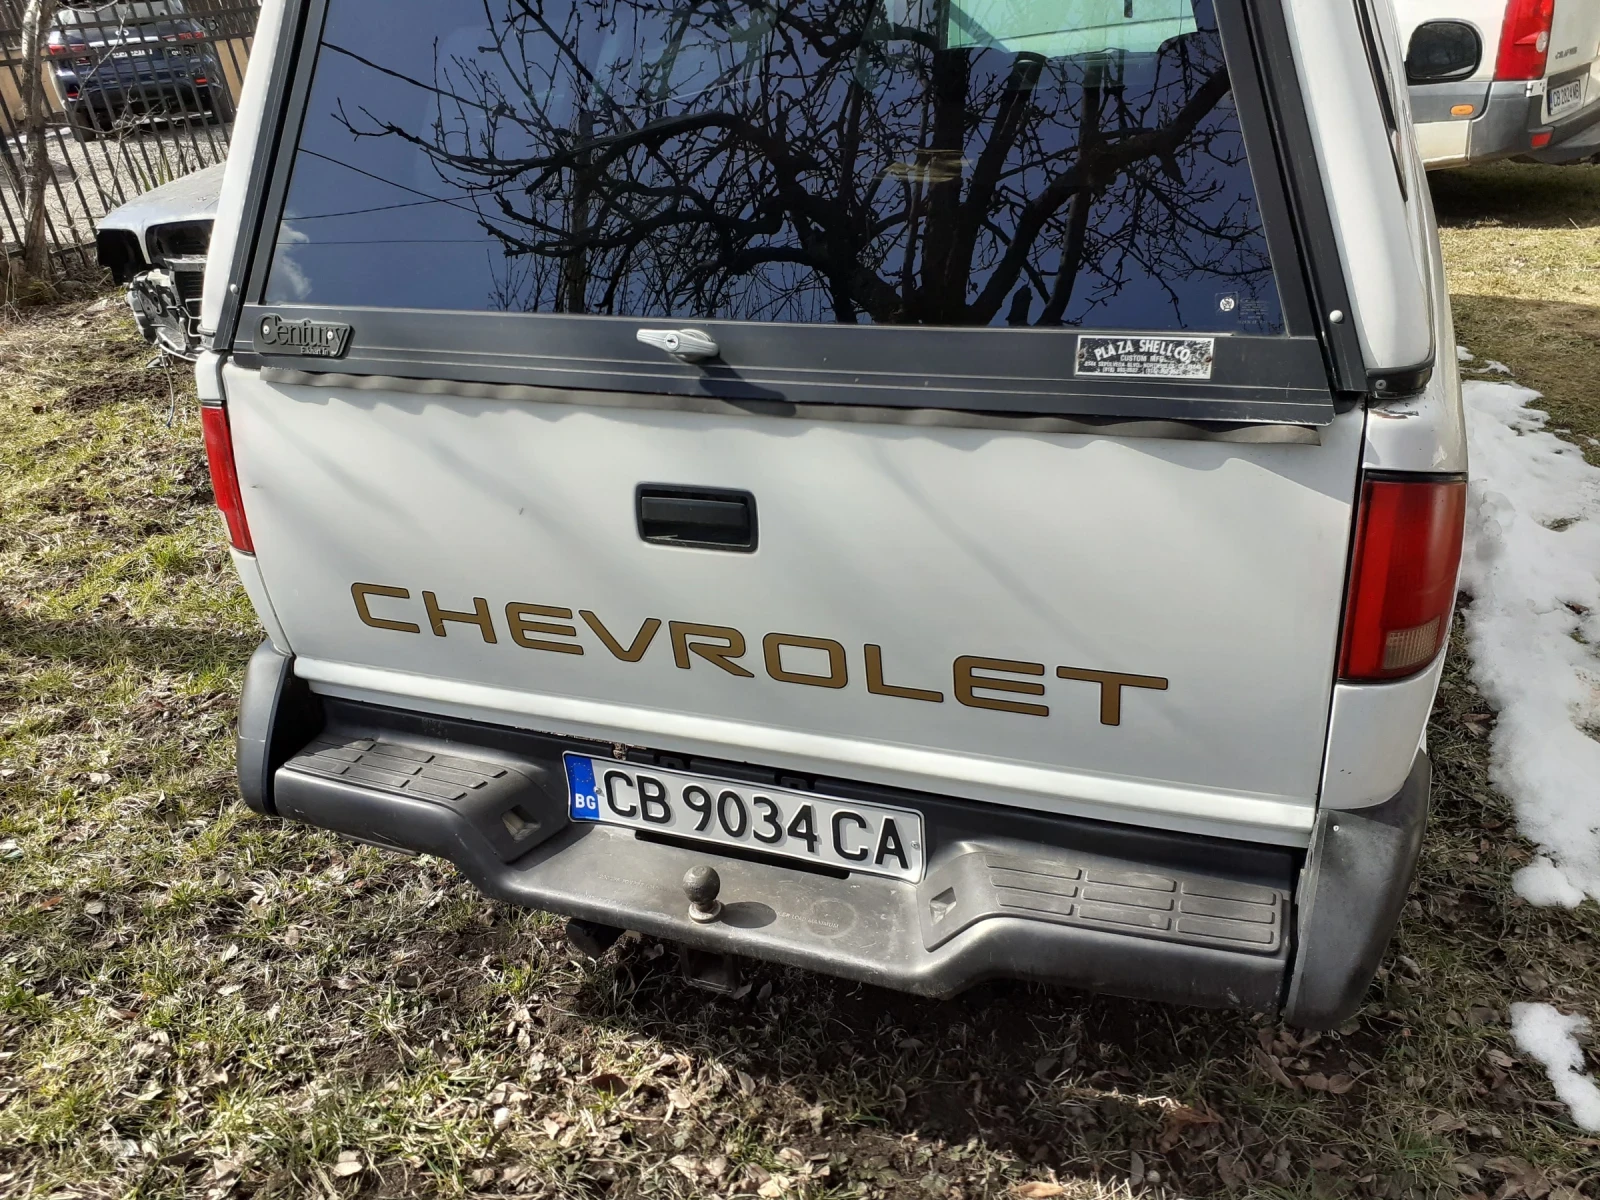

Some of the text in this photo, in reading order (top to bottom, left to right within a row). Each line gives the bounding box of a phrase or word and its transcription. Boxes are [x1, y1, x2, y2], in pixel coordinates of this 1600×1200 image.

[260, 314, 348, 356] Century
[1093, 340, 1134, 361] PLAZA
[1139, 339, 1173, 357] SHELL
[1120, 354, 1147, 362] CUSTOM
[351, 582, 1169, 727] CHEVROLET
[575, 792, 597, 810] BG
[603, 768, 910, 870] CB 9034 CA
